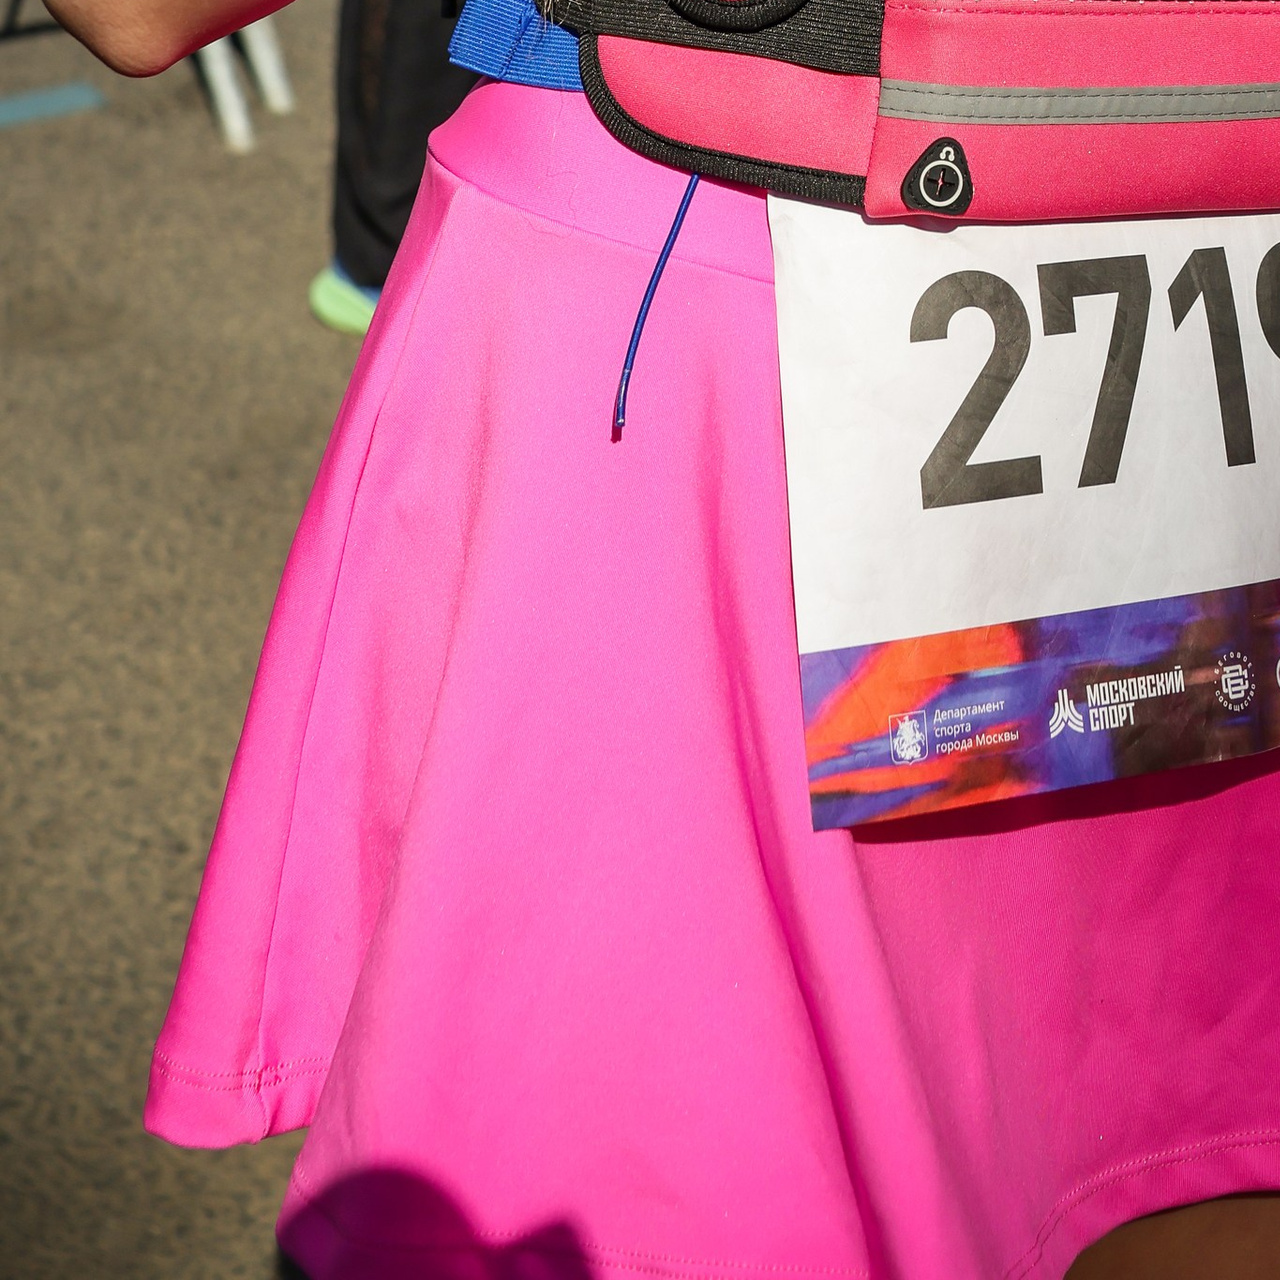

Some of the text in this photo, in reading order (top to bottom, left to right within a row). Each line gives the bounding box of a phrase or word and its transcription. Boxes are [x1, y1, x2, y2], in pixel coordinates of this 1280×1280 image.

[1086, 665, 1185, 707] МОСКОВСКИЙ
[1215, 683, 1256, 712] СООБЩЕСТВО
[933, 700, 1006, 725] Департамент
[1088, 702, 1135, 732] СПОРТ
[934, 721, 972, 738] спорта
[935, 729, 1019, 755] города Москвы
